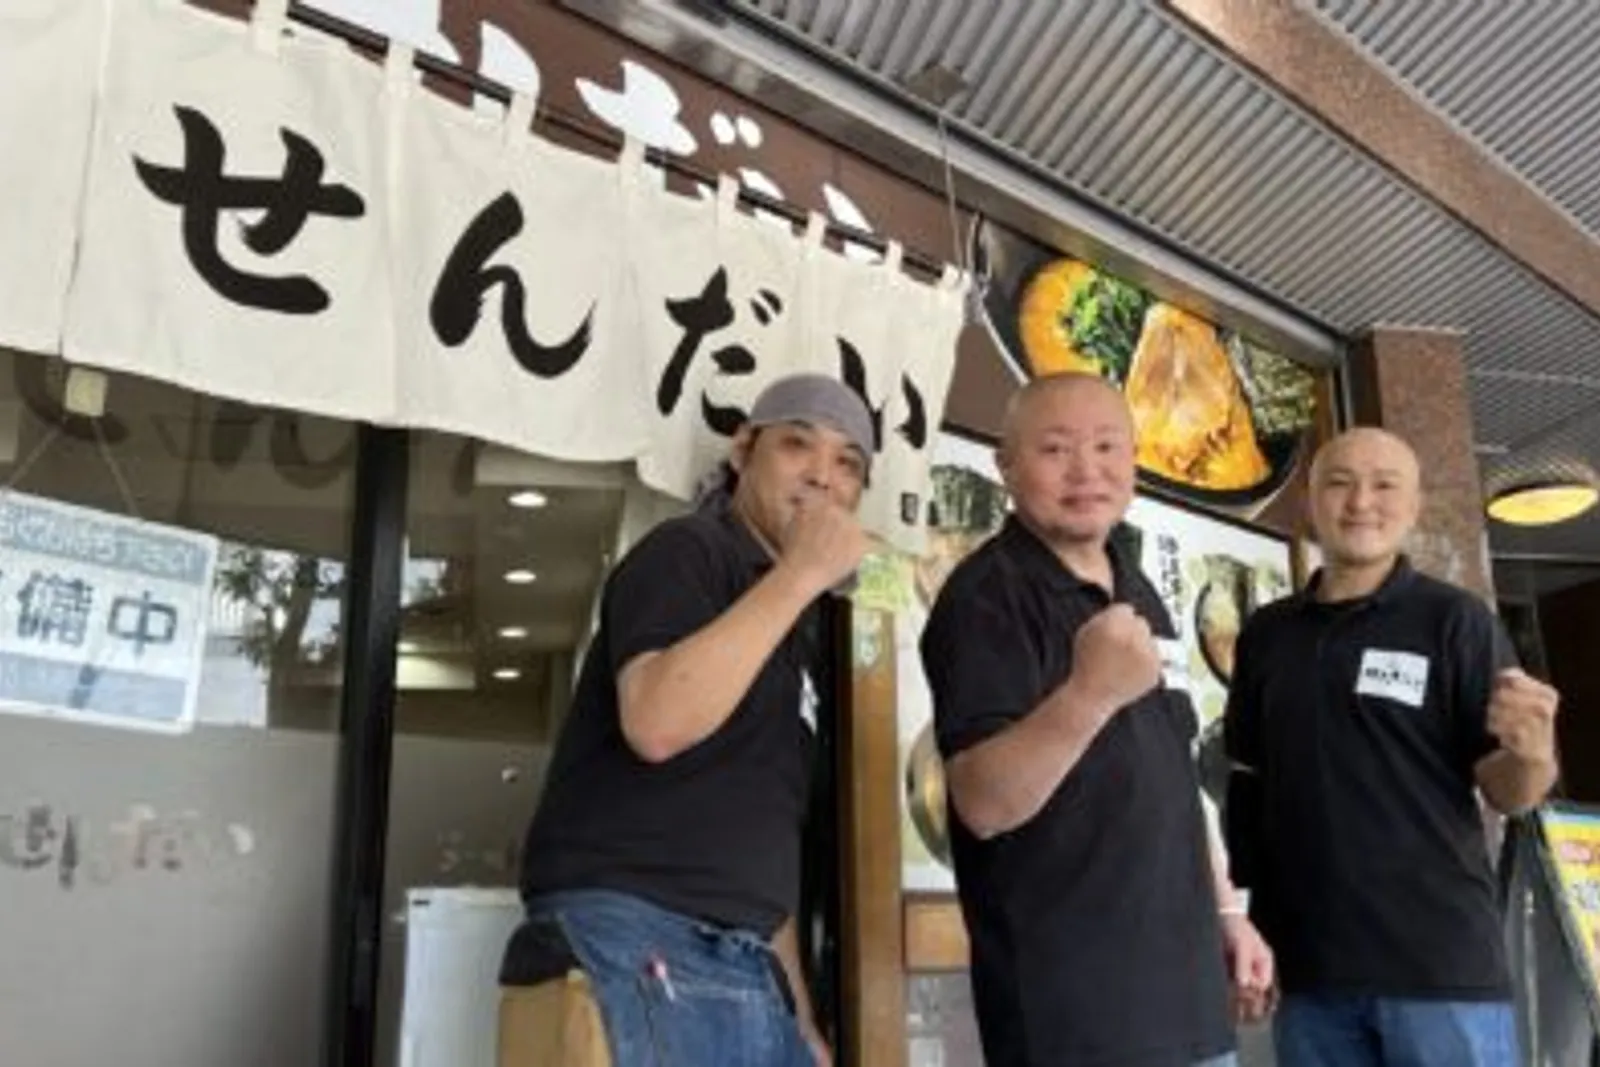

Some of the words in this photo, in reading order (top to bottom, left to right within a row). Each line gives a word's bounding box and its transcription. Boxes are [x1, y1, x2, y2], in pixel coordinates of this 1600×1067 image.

[133, 103, 928, 452] せんだい
[0, 568, 179, 656] 備中
